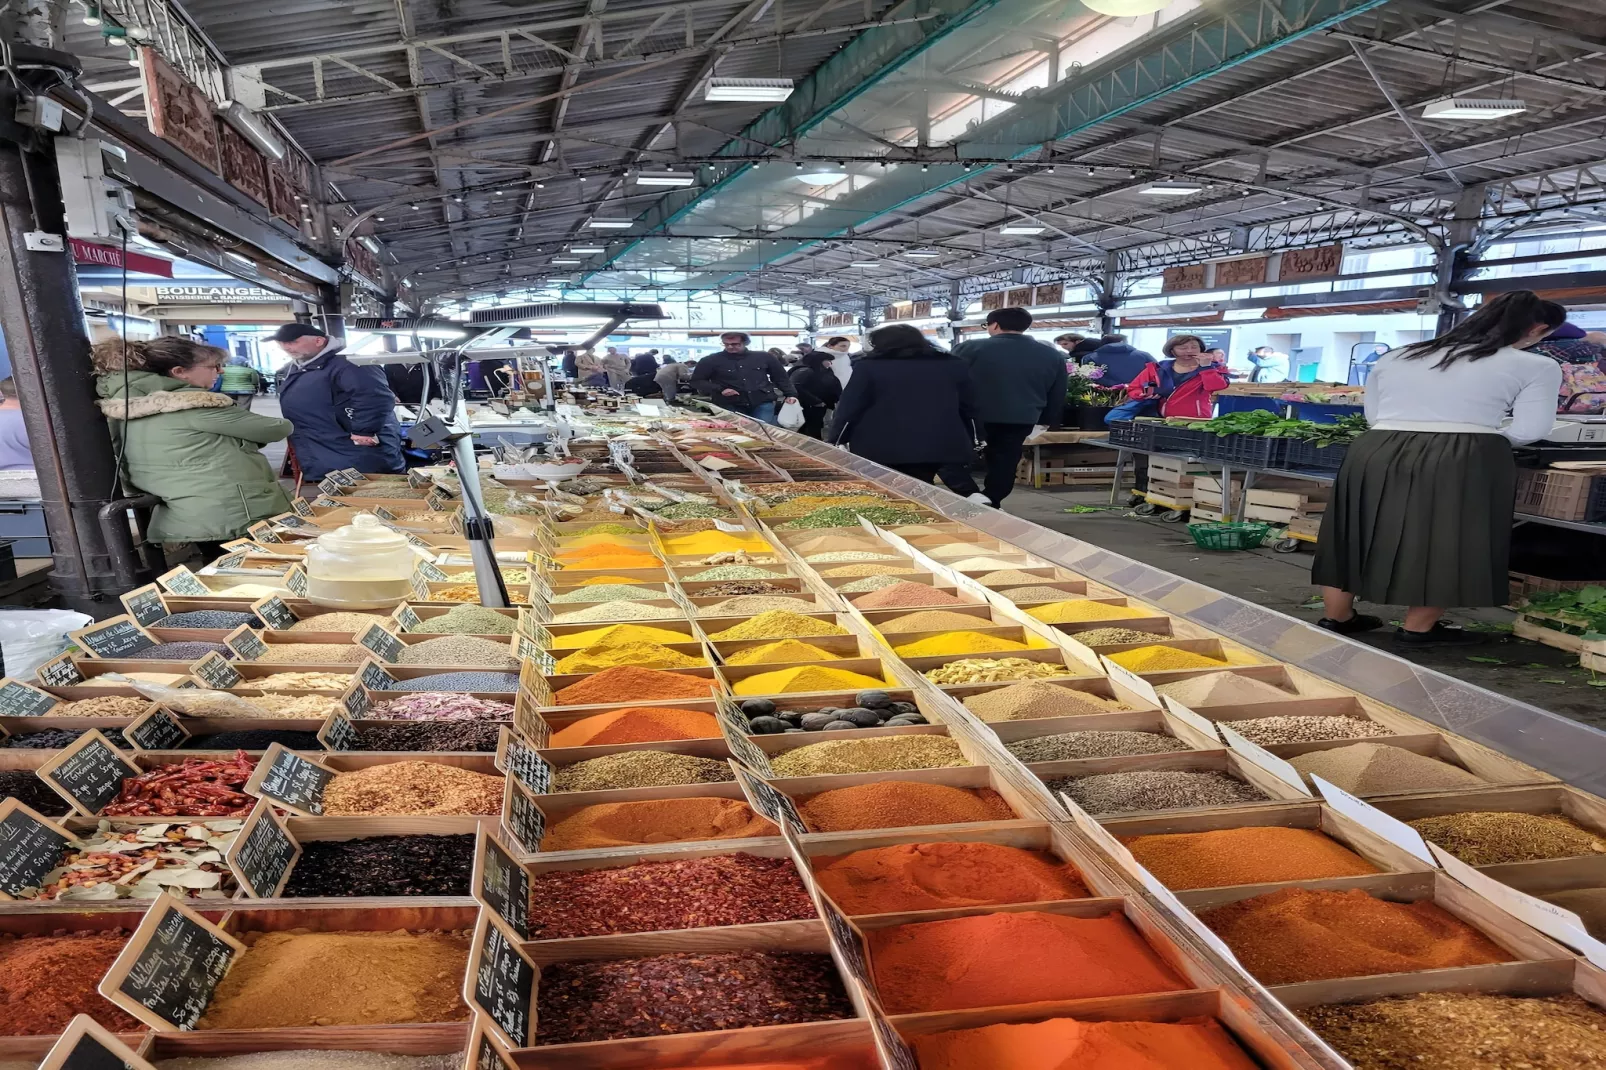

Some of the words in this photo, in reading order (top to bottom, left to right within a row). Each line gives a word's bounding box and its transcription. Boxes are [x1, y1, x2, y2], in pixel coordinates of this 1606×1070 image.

[82, 246, 123, 267] MARCHÉ
[129, 948, 169, 990] Mélange
[189, 978, 201, 992] 5€
